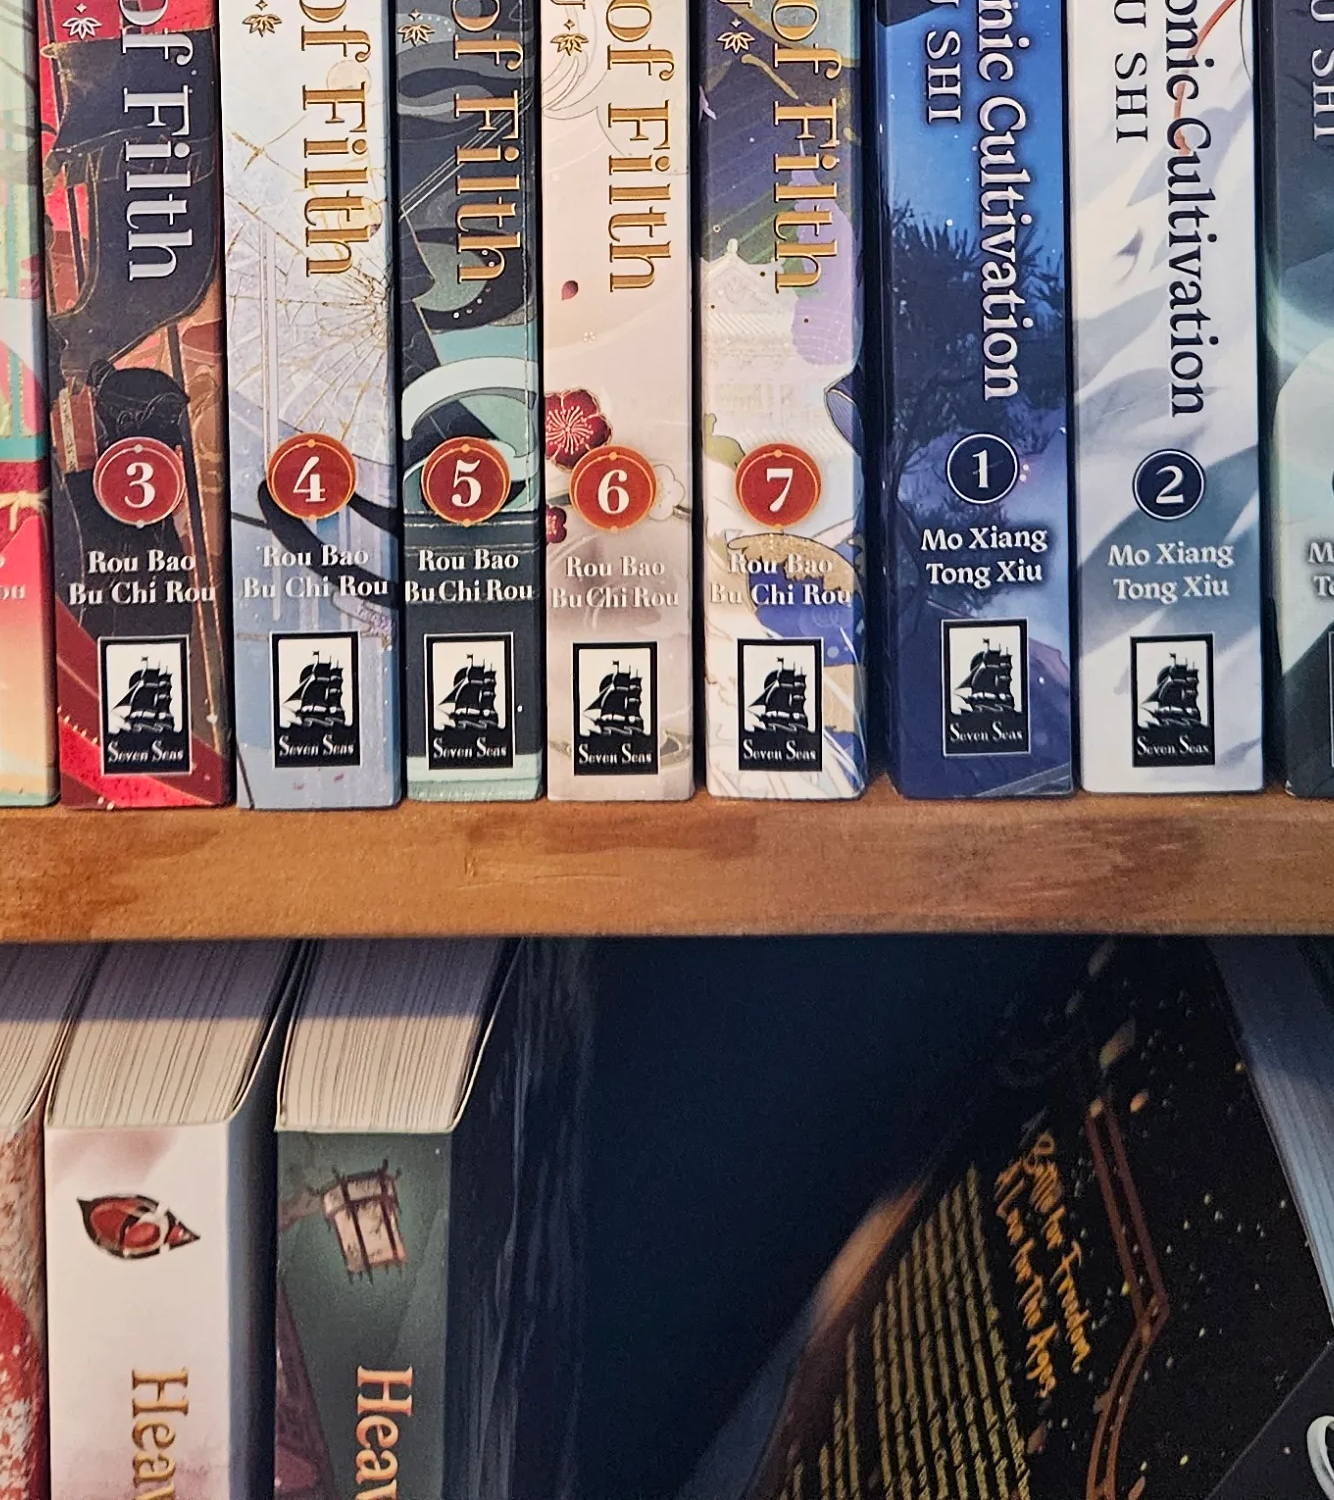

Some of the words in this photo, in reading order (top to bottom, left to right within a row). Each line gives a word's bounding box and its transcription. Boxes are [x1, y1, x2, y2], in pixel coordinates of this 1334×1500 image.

[926, 30, 962, 125] SHI
[122, 85, 193, 280] Filth
[302, 81, 370, 278] Filth
[454, 89, 521, 284] Filth
[608, 99, 671, 292] Filth
[774, 98, 840, 293] Filth
[978, 96, 1033, 401] Cultivation
[1167, 117, 1218, 416] Cultivation
[124, 462, 155, 508] 3
[292, 456, 326, 503] 4
[451, 459, 482, 507] 5
[598, 469, 630, 514] 6
[766, 468, 794, 512] 7
[972, 450, 989, 489] 1
[1155, 465, 1184, 503] 2
[921, 529, 962, 551] Mo
[968, 528, 1048, 552] Xiang
[926, 563, 991, 588] Tong
[997, 560, 1042, 582] Xiu
